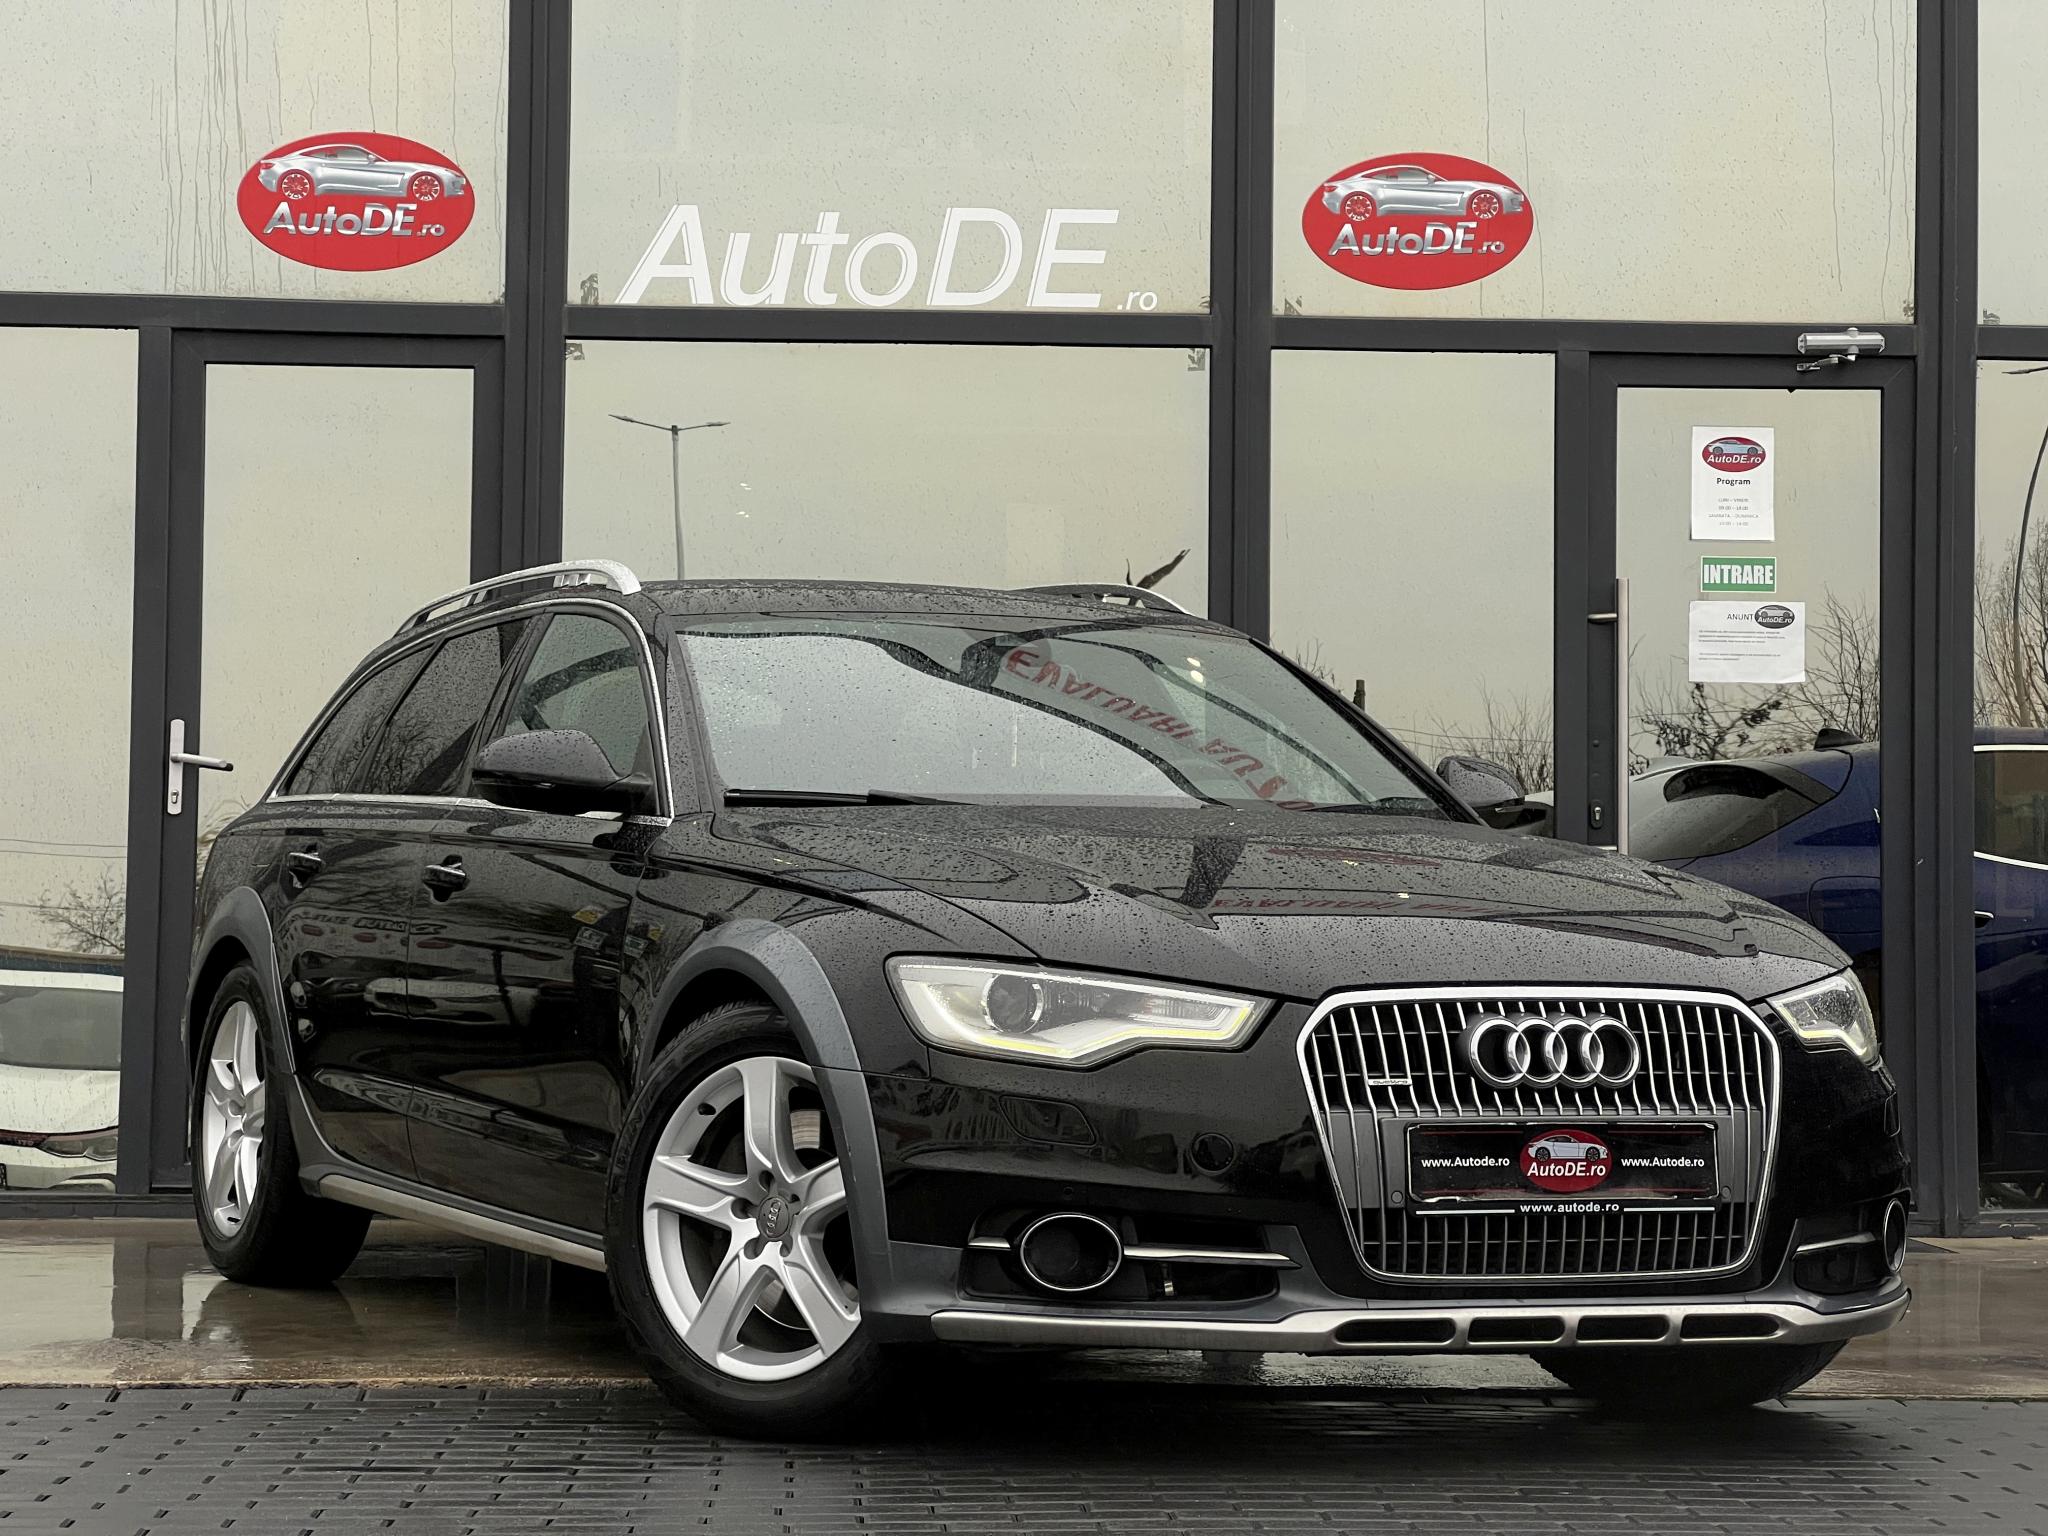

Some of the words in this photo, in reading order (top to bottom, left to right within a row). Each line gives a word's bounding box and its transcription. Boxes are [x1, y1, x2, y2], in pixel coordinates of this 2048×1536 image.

[1707, 454, 1762, 464] AutoDE.ro
[1716, 477, 1751, 486] Program
[1703, 564, 1774, 585] INTRARE
[1421, 1156, 1511, 1168] www.Autode.ro
[1621, 1156, 1705, 1168] www.Autode.ro
[1526, 1161, 1606, 1177] AutoDE.ro
[1519, 1202, 1620, 1213] www.autode.ro
